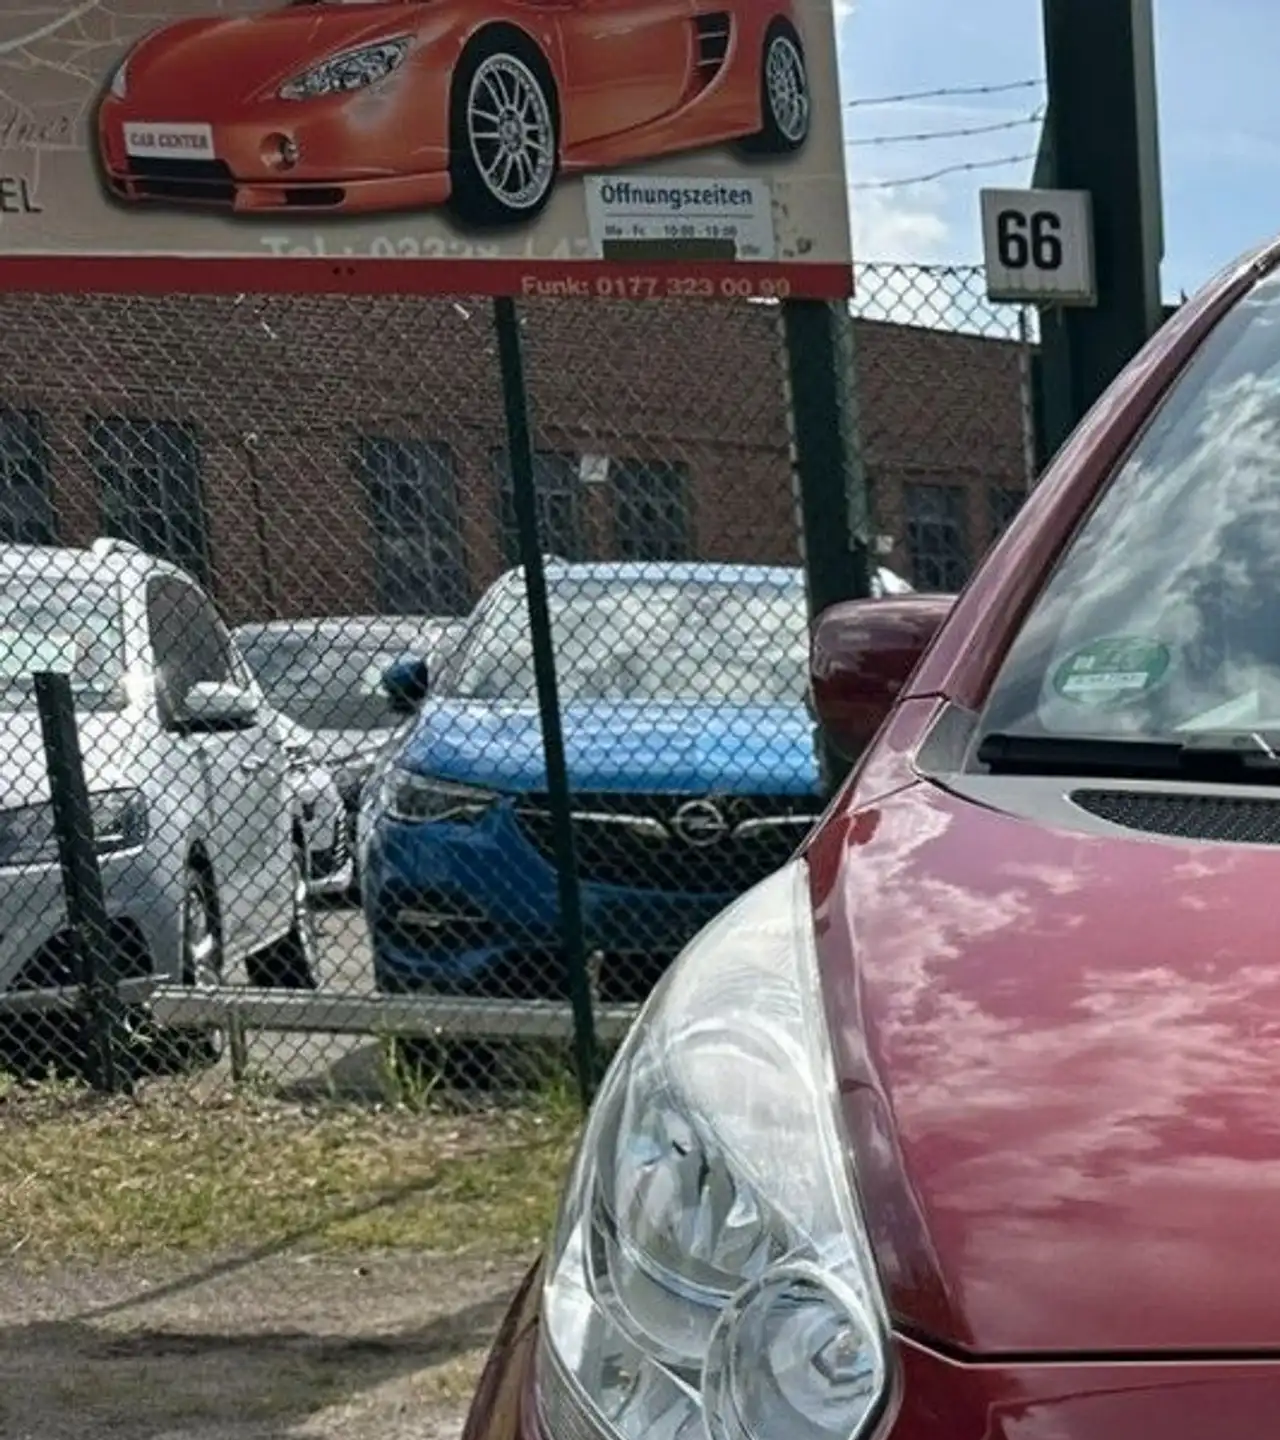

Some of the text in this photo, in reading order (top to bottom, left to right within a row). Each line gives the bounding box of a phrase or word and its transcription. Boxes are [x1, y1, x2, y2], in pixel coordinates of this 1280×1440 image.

[131, 132, 209, 149] CAR CENTER
[601, 181, 753, 209] Öffnungszeiten
[997, 209, 1062, 271] 66
[521, 276, 589, 295] Funk:
[596, 276, 658, 297] 0177
[665, 277, 714, 296] 323
[719, 278, 752, 296] 00
